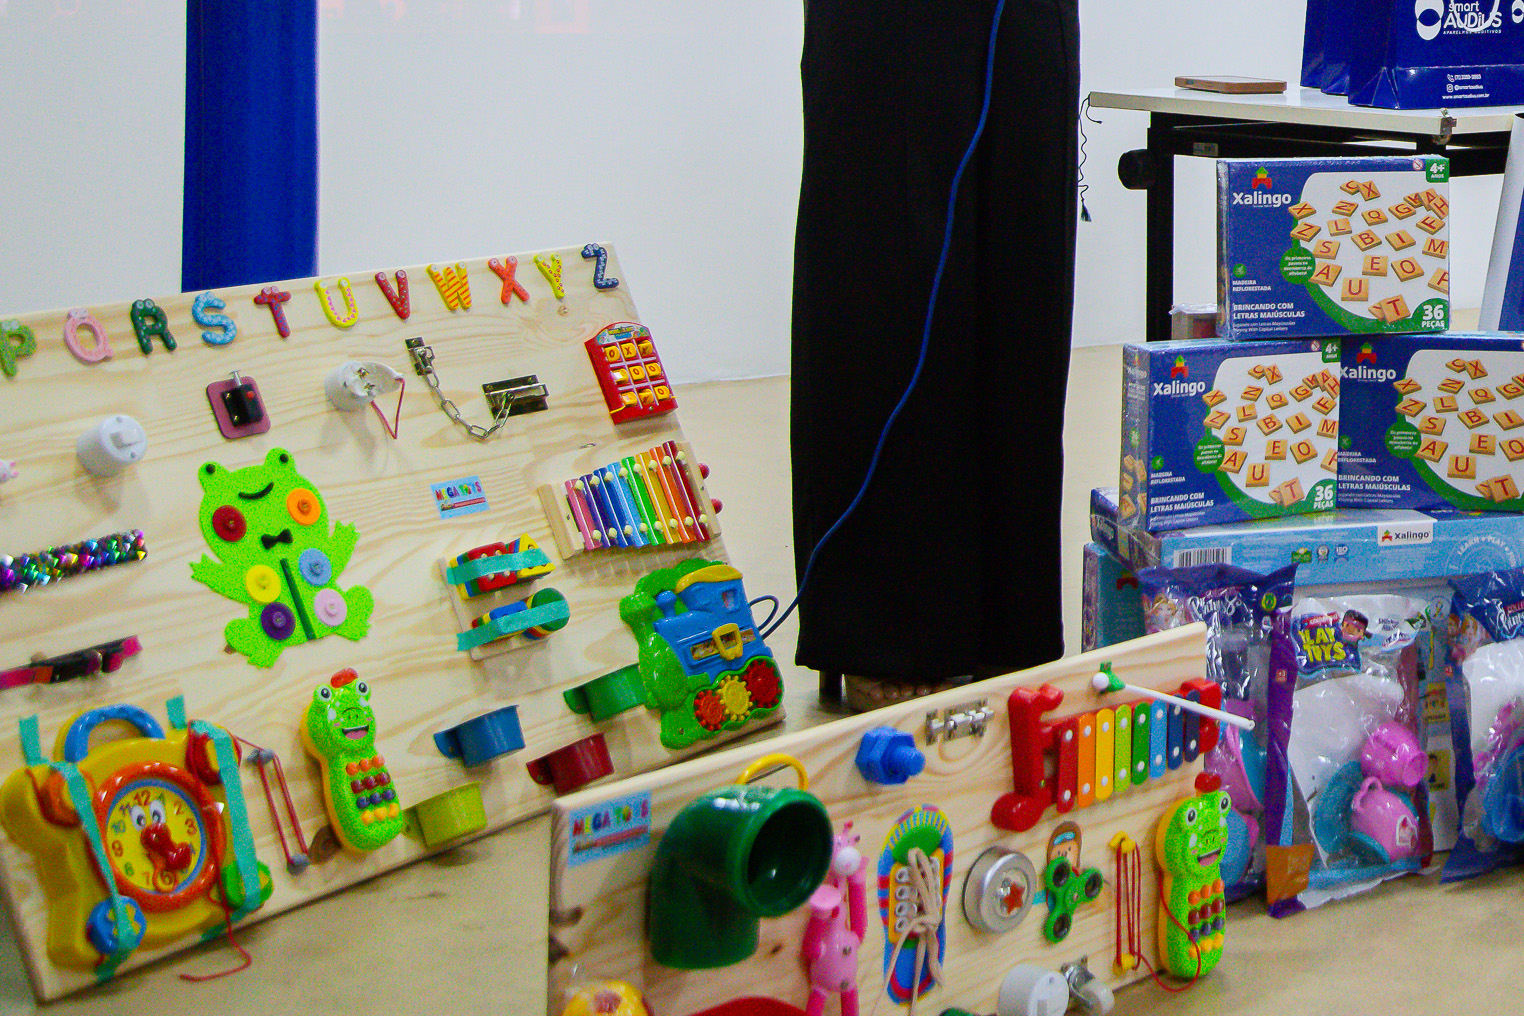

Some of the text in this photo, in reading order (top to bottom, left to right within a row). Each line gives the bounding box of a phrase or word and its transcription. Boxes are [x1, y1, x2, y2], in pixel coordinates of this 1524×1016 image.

[1448, 0, 1480, 12] smart
[1429, 162, 1445, 173] 4+
[1232, 191, 1292, 208] Xalingo
[1233, 302, 1294, 311] BRINCANDO COM
[1233, 309, 1306, 320] LETRAS MAIÚSCULAS
[1423, 304, 1444, 321] 36
[1421, 320, 1445, 330] PEÇAS
[1325, 343, 1338, 354] 4+
[1153, 380, 1206, 397] Xalingo
[1338, 474, 1381, 482] BRINCANDO
[1338, 482, 1411, 491] LETRAS MAIÚSCULAS
[1151, 492, 1205, 504] BRINCANDO COM
[1314, 485, 1333, 501] 36
[1150, 499, 1214, 513] LETRAS MAIÚSCULAS
[1313, 500, 1334, 510] PEÇAS
[1394, 530, 1430, 541] Xalingo
[1303, 641, 1347, 663] TOYS
